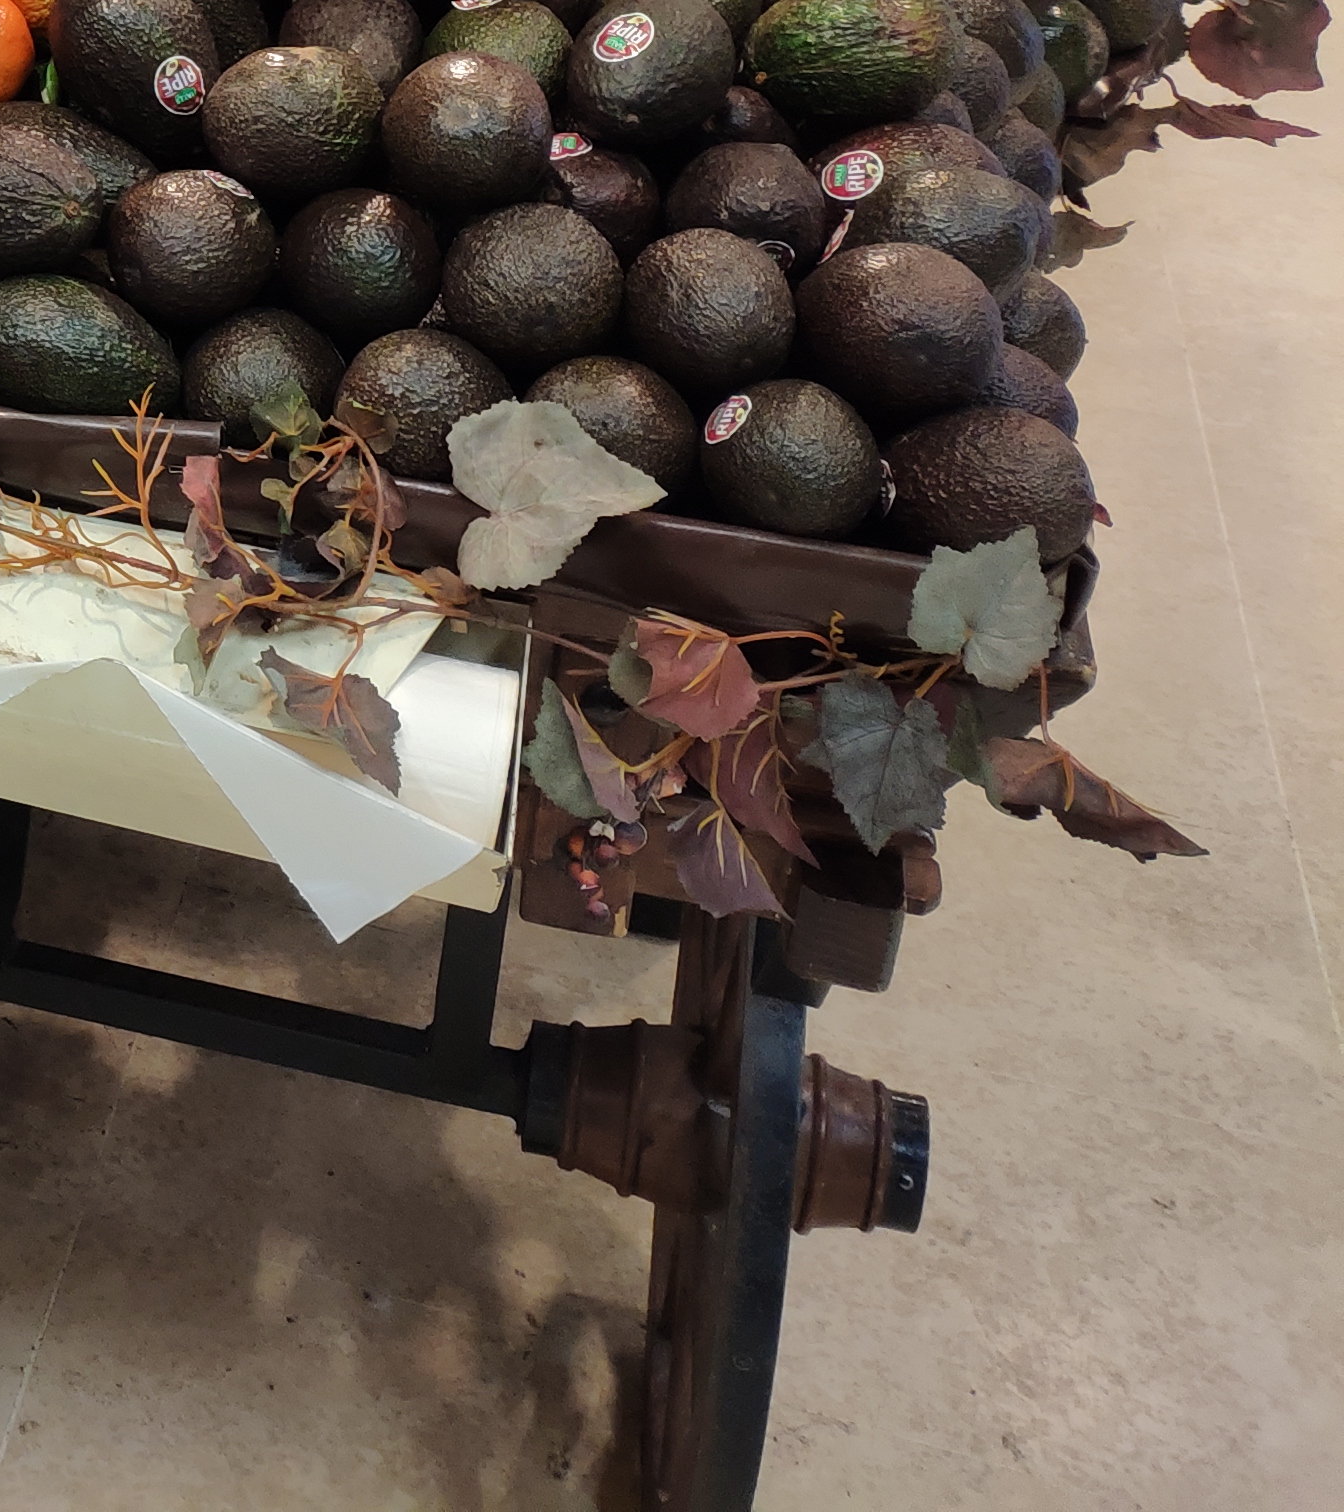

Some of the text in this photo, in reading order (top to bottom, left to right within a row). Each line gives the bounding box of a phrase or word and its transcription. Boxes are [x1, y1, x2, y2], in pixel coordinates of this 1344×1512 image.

[607, 20, 648, 45] RIPE
[159, 65, 197, 98] RIPE
[847, 155, 868, 191] RIPE
[715, 401, 740, 436] RIPE
